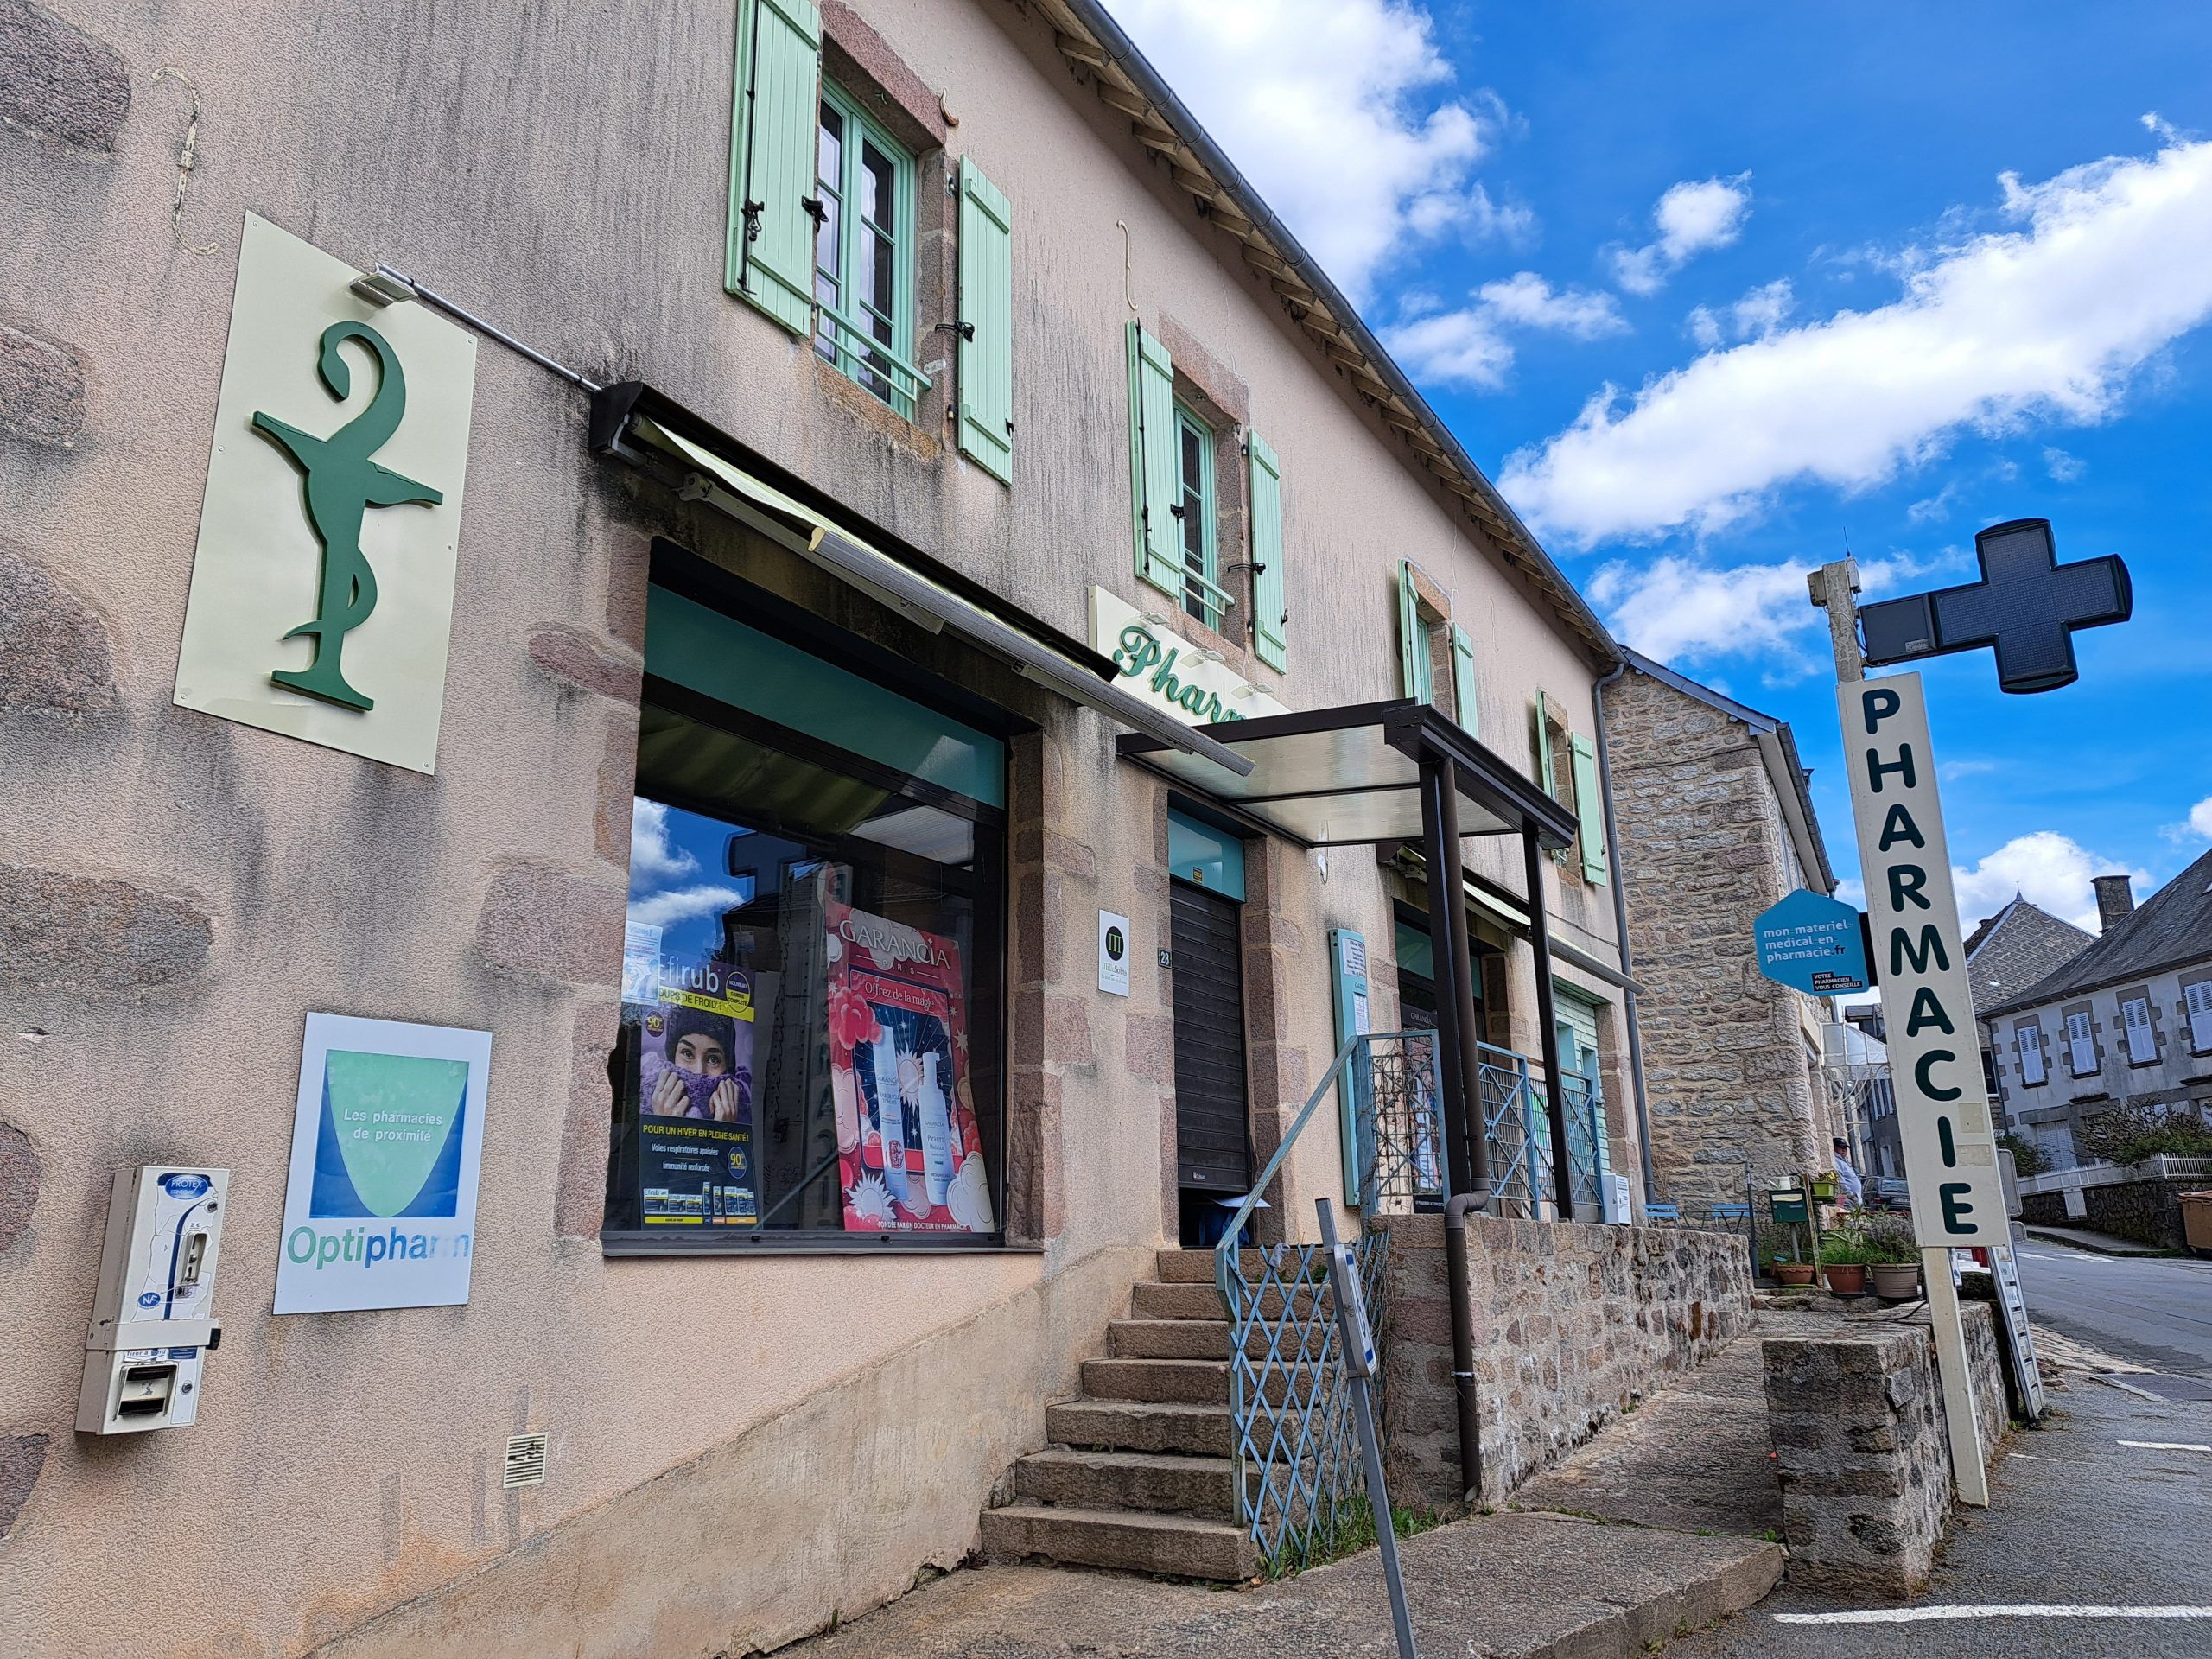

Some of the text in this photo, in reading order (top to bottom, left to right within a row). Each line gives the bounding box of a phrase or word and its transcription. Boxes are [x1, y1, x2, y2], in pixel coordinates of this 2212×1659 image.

[1765, 934, 1838, 950] medical-en-
[1160, 951, 1170, 965] 28
[1766, 944, 1847, 964] pharmacie.fr
[882, 959, 915, 975] PARIS
[1861, 688, 1979, 1236] PHARMACIE
[683, 994, 692, 1003] DE
[865, 982, 935, 1011] Offrez de la magie
[344, 1108, 442, 1125] Les pharmacies
[353, 1127, 431, 1141] de proximité
[643, 1124, 664, 1135] POUR
[666, 1127, 676, 1135] UN
[677, 1128, 697, 1137] HIVER
[709, 1130, 728, 1140] PLEINE
[728, 1133, 747, 1142] SANTÉ
[652, 1143, 666, 1152] Voies
[667, 1145, 699, 1154] respiratoires
[663, 1161, 688, 1170] Immunité
[171, 1179, 202, 1189] PROTEX
[143, 1294, 158, 1305] NF
